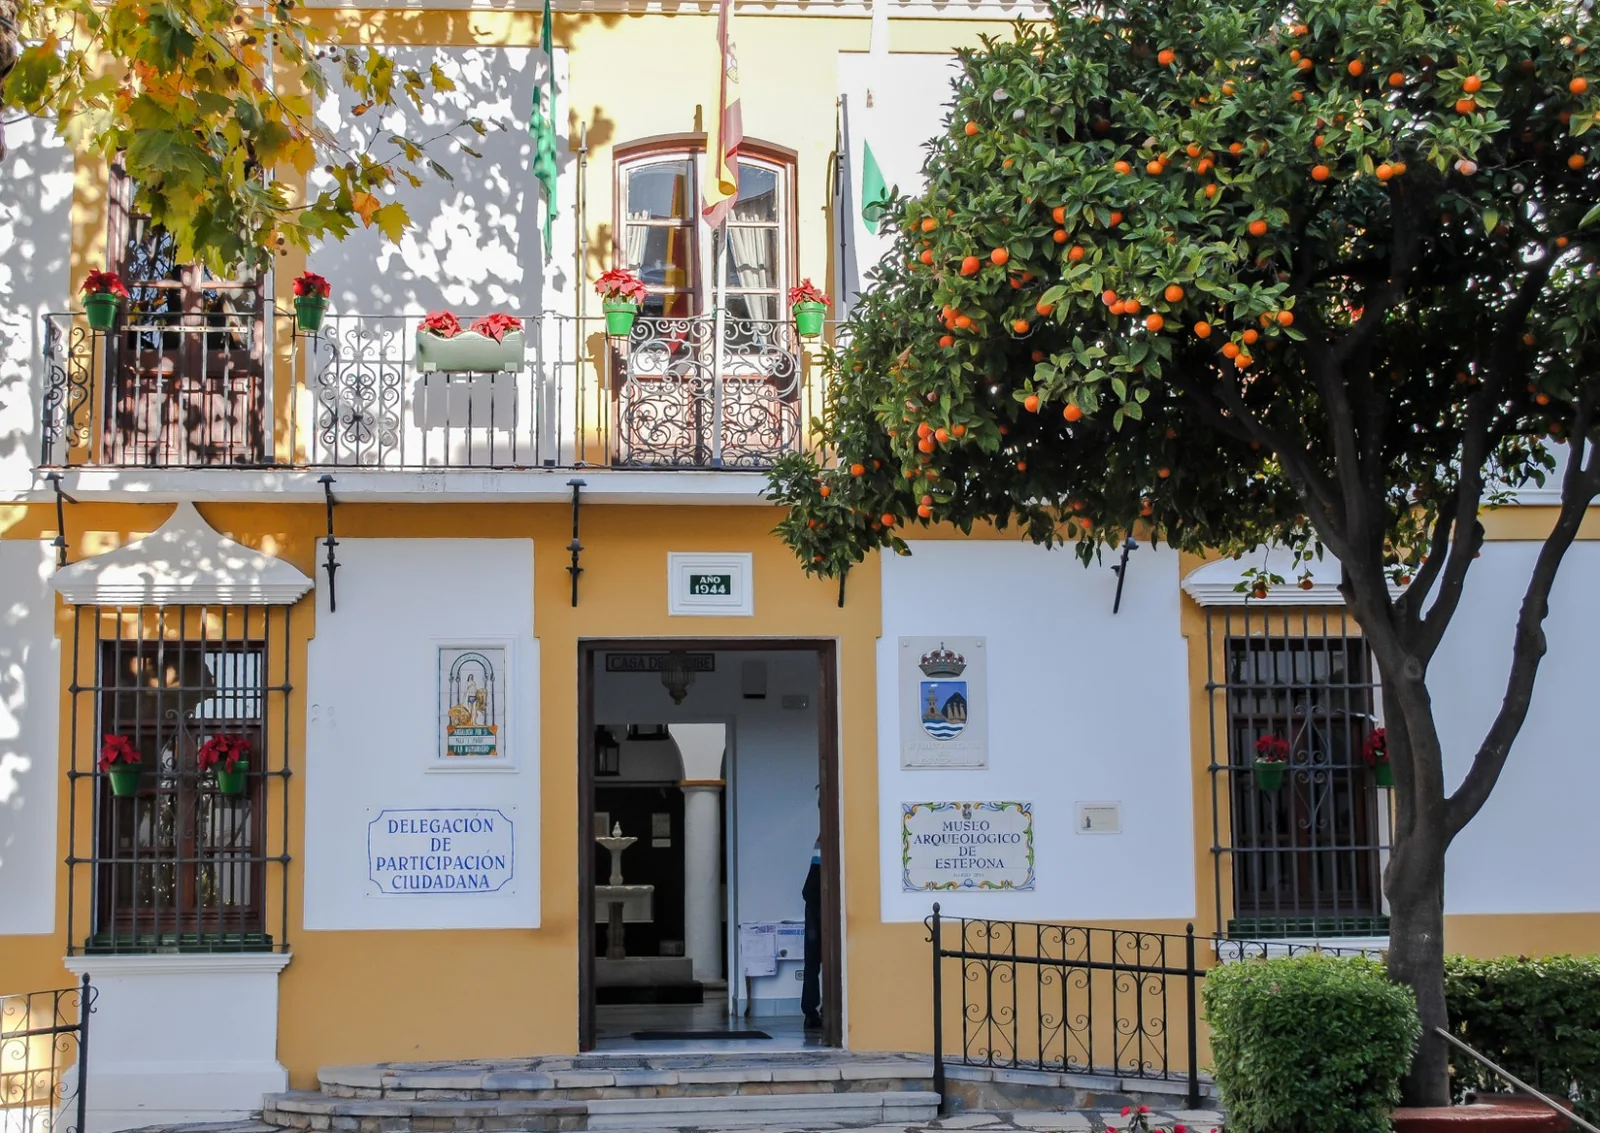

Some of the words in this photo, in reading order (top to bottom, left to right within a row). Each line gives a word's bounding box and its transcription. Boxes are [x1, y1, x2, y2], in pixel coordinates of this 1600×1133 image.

[700, 574, 721, 584] AÑO
[695, 584, 726, 594] 1944
[610, 656, 646, 670] CASA
[388, 812, 494, 834] DELEGACIÓN
[942, 820, 990, 832] MUSEO
[430, 837, 451, 852] DE
[958, 846, 977, 857] DE
[376, 849, 505, 871] PARTICIPACIÓN
[935, 858, 1005, 869] ESTEPONA
[391, 874, 490, 889] CIUDADANA
